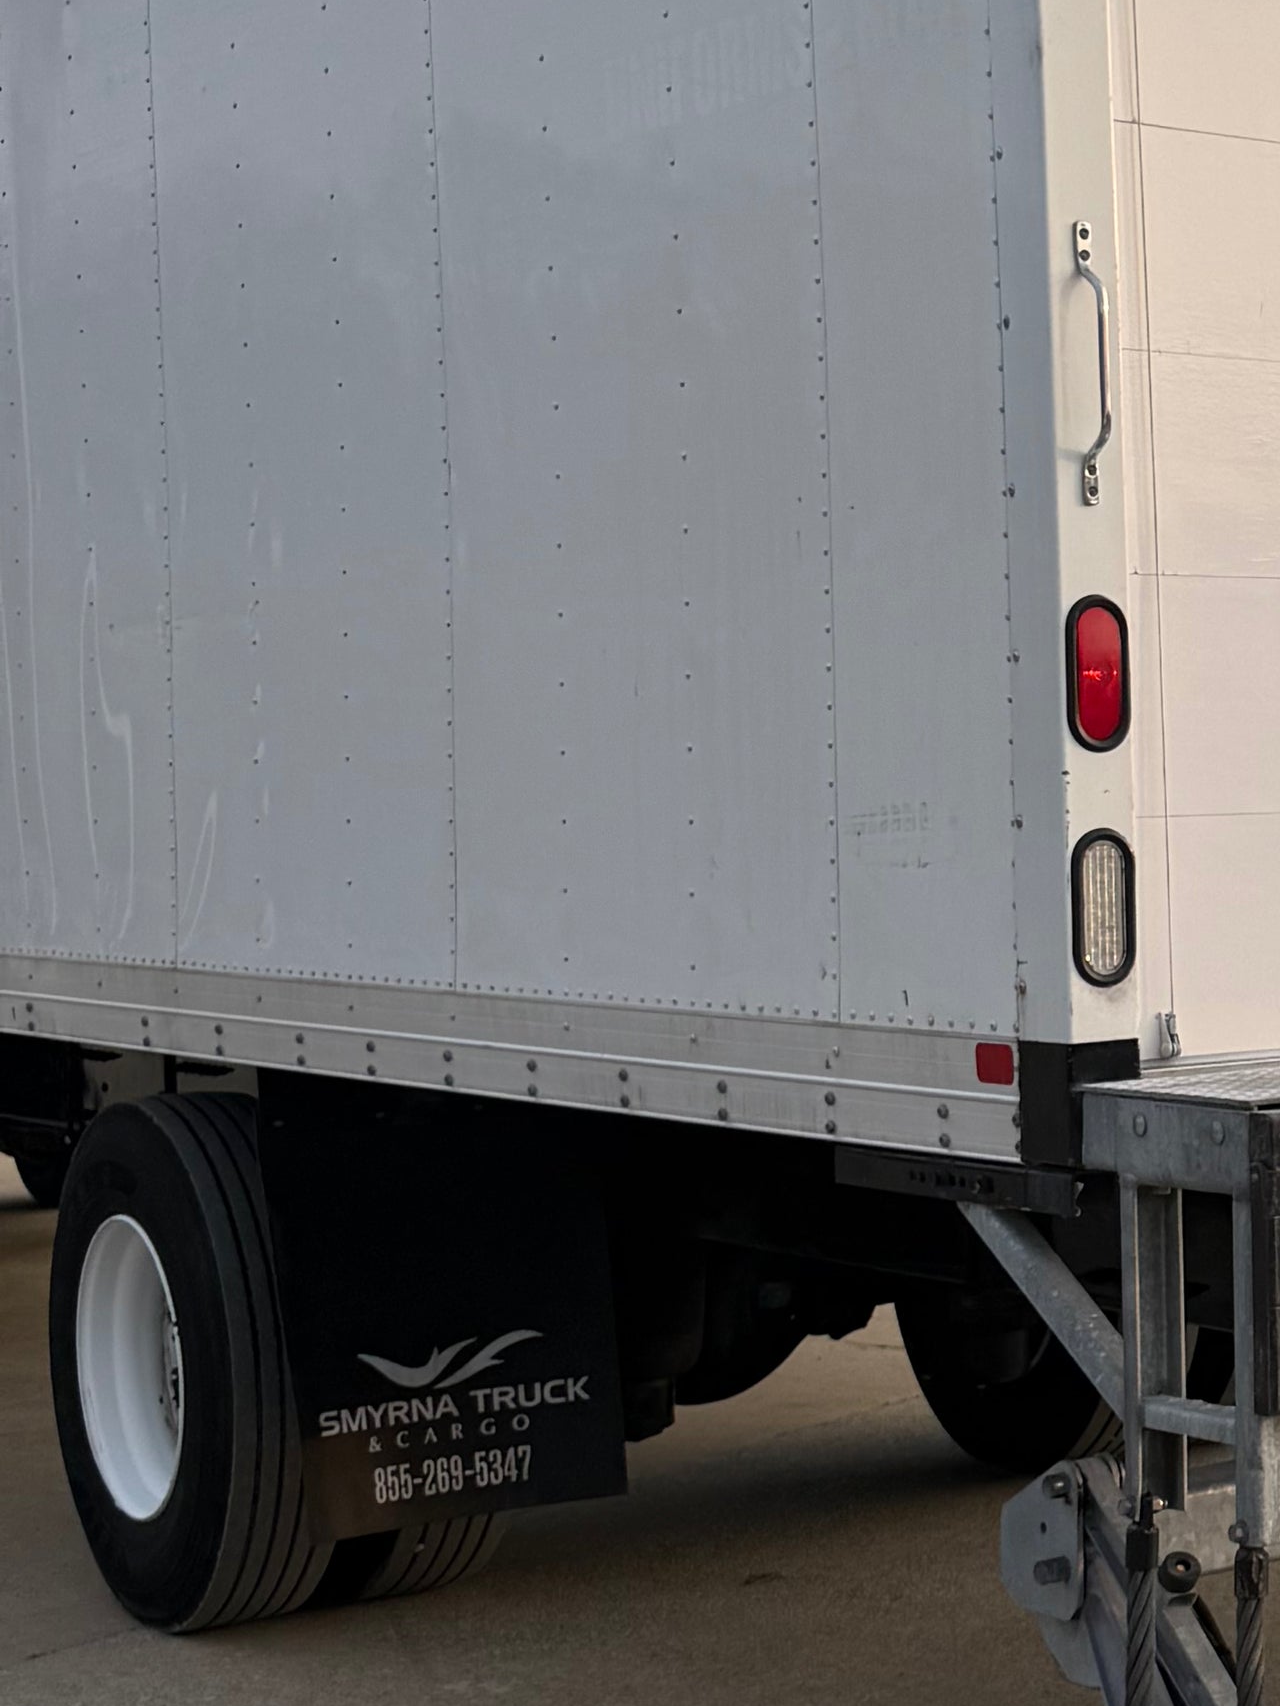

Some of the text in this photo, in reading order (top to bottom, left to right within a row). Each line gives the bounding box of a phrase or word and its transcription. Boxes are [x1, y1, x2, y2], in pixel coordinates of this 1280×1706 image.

[319, 1375, 591, 1437] SMYRNA TRUCK
[368, 1414, 530, 1453] & CARGO
[373, 1444, 532, 1504] 855-269-5347
